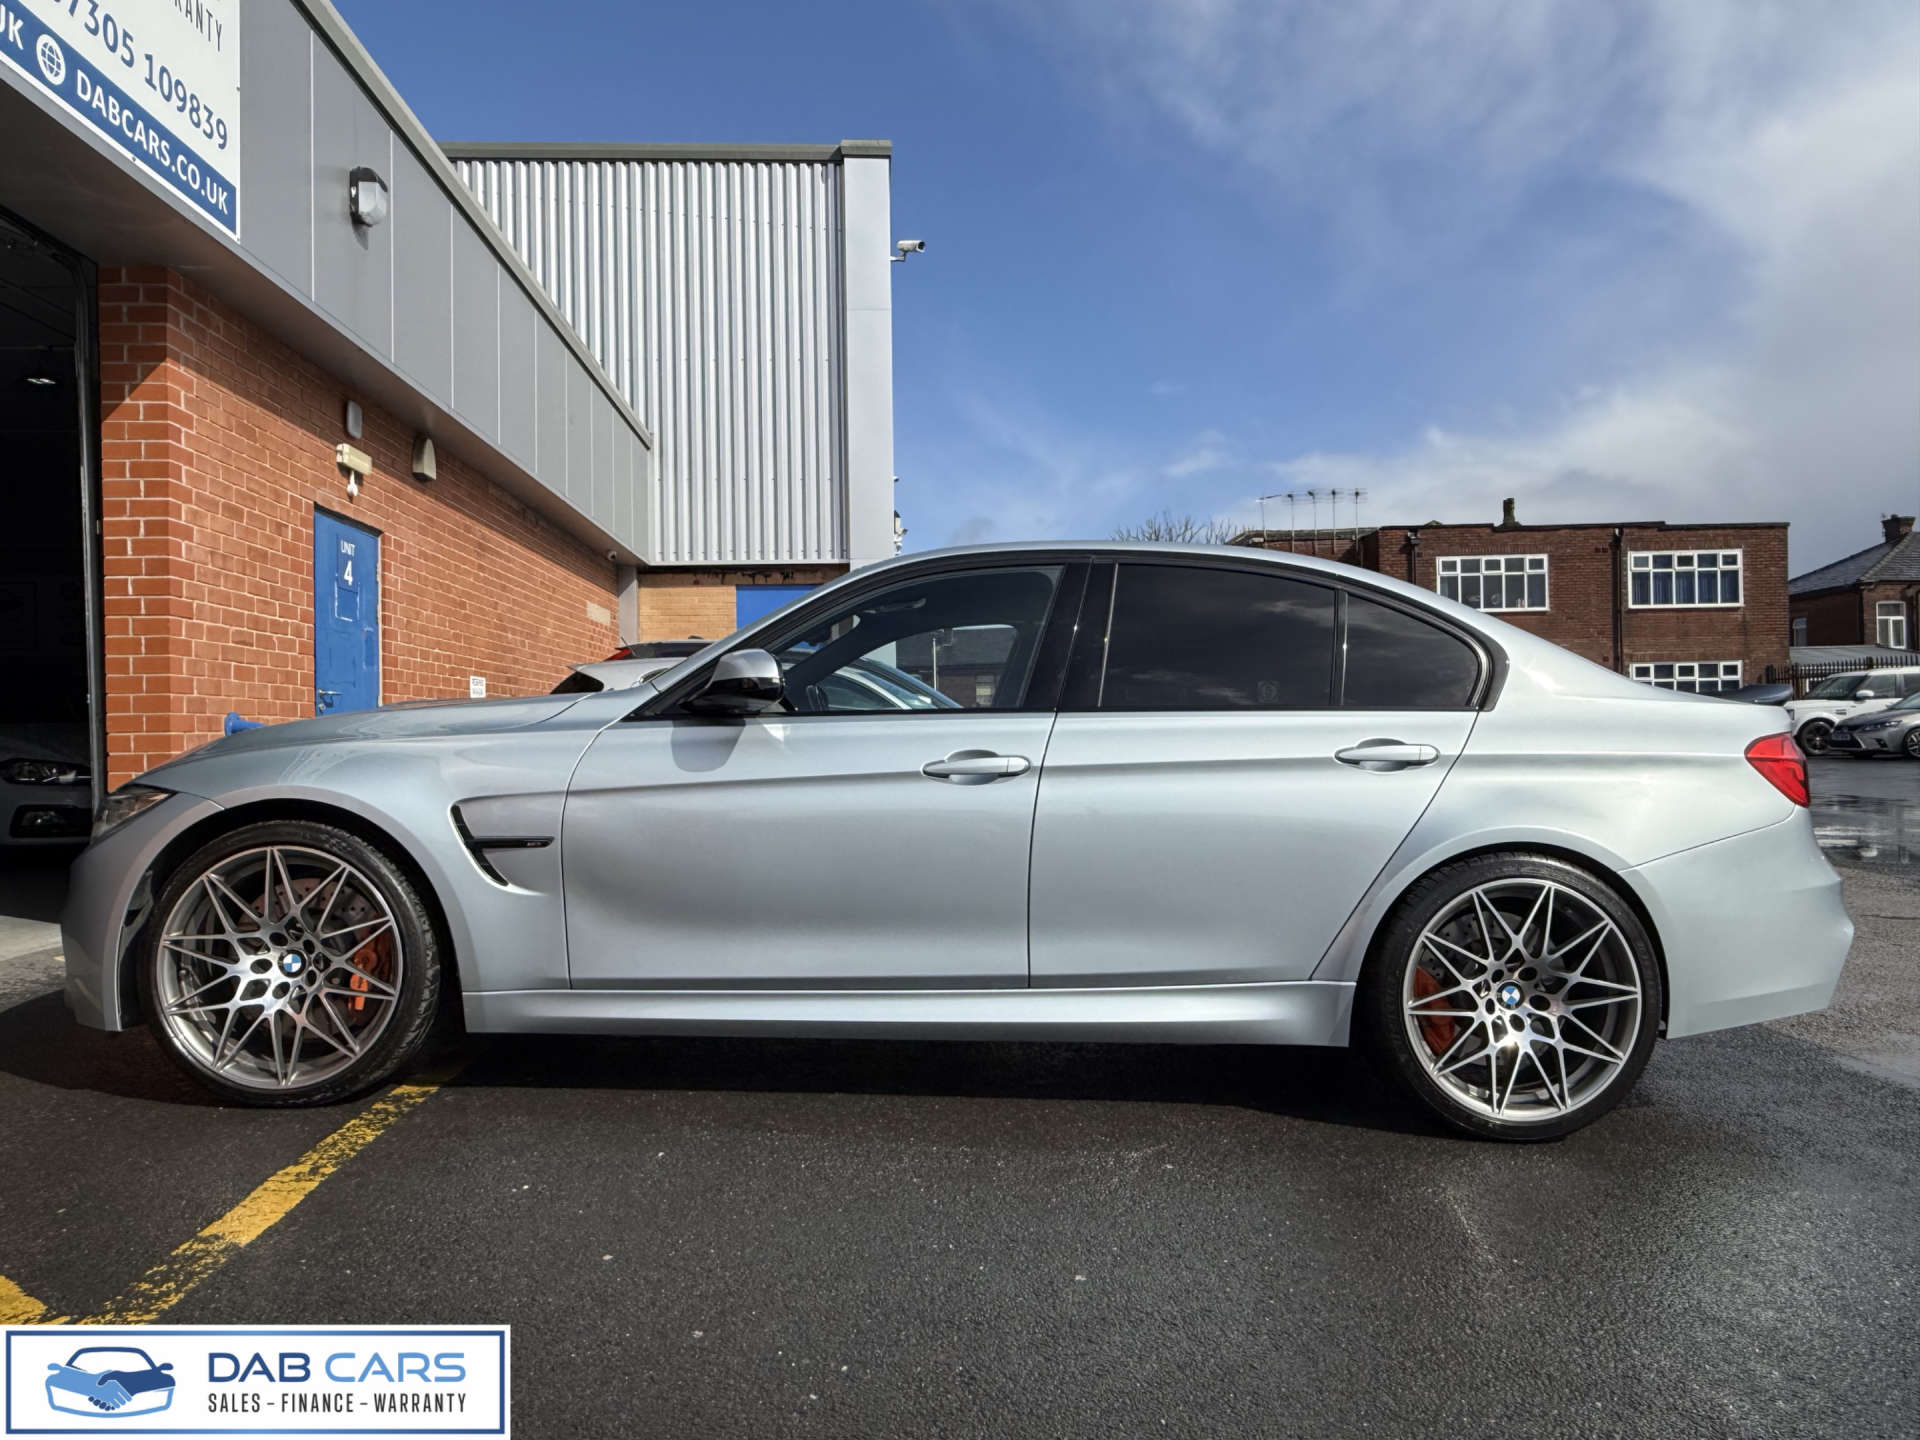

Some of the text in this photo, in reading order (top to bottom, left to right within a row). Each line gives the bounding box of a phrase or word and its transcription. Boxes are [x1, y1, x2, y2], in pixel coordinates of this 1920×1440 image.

[53, 0, 228, 150] 305 109839
[76, 68, 228, 215] DABCARS.CO.UK
[343, 560, 353, 586] 4
